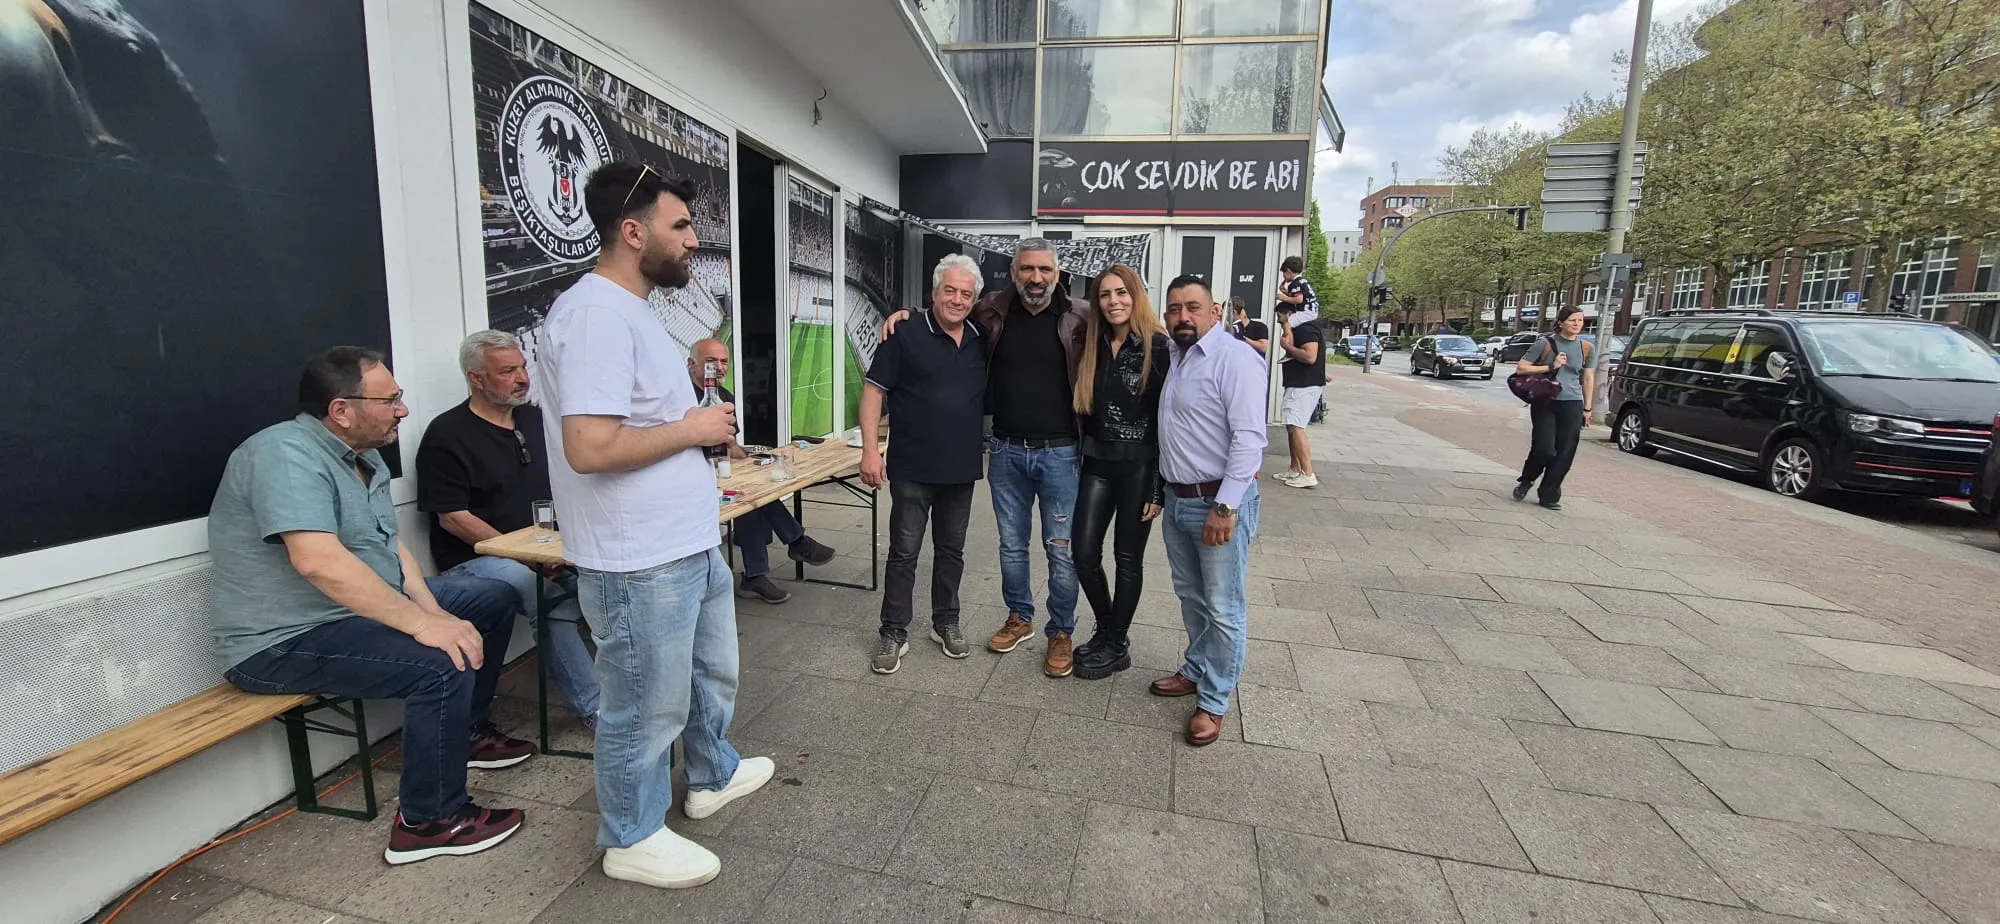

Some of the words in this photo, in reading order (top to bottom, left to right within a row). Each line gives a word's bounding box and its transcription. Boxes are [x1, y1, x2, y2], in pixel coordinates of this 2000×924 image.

[505, 96, 526, 147] KUZEY
[525, 83, 610, 165] ALMANYA-HAMBUR
[1081, 159, 1131, 192] ÇOK
[1228, 160, 1257, 190] BE
[1239, 274, 1254, 283] BJK
